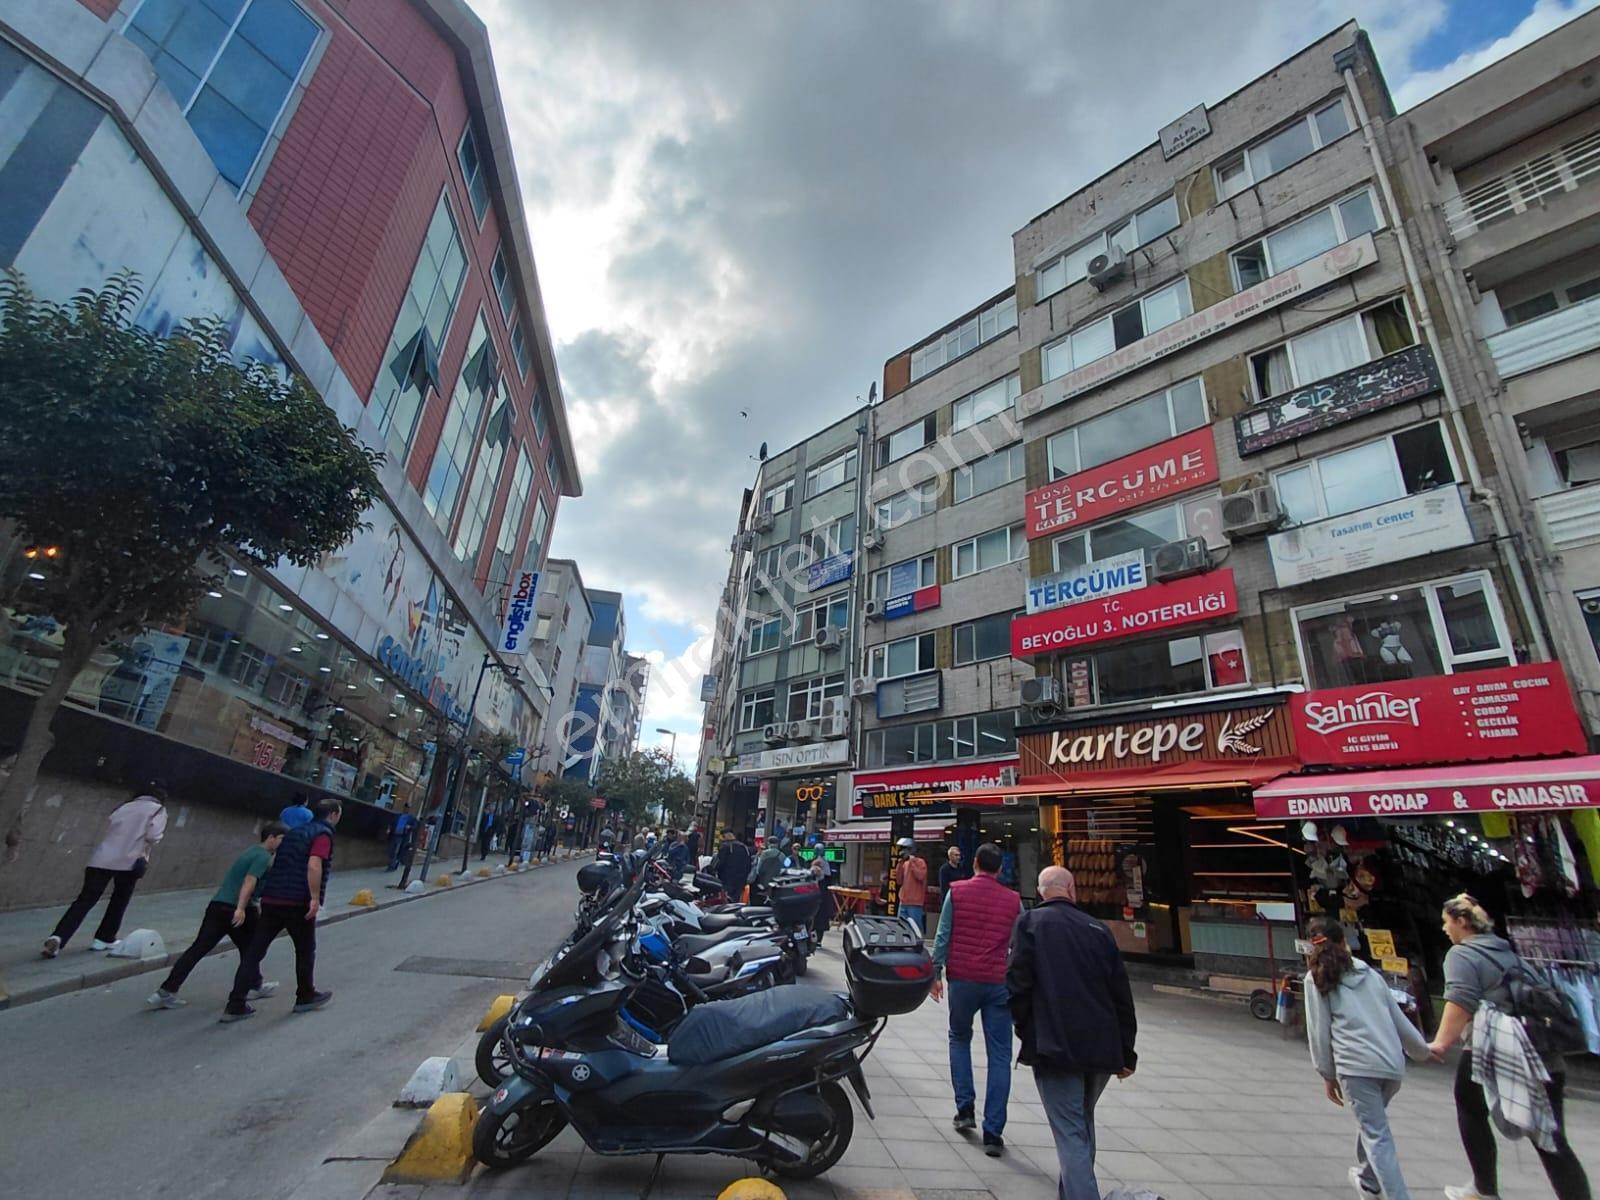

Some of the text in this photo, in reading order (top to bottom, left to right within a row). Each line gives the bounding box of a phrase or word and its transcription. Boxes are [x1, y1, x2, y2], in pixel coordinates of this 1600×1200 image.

[1172, 126, 1197, 144] ALFA
[1034, 449, 1204, 520] TERCÜME
[1376, 510, 1415, 527] Center
[1029, 562, 1142, 608] TERCÜME
[504, 571, 532, 651] englishbox
[1021, 623, 1099, 650] BEYOĞLU
[1103, 619, 1117, 633] 3.
[1121, 591, 1227, 629] NOTERLİĞİ
[255, 743, 274, 769] 15
[1048, 721, 1205, 765] kartepe
[964, 775, 1004, 791] MAĞAZ
[873, 792, 898, 808] DARK
[1287, 785, 1590, 816] EDANUR ÇORAP & ÇAMAŞIR
